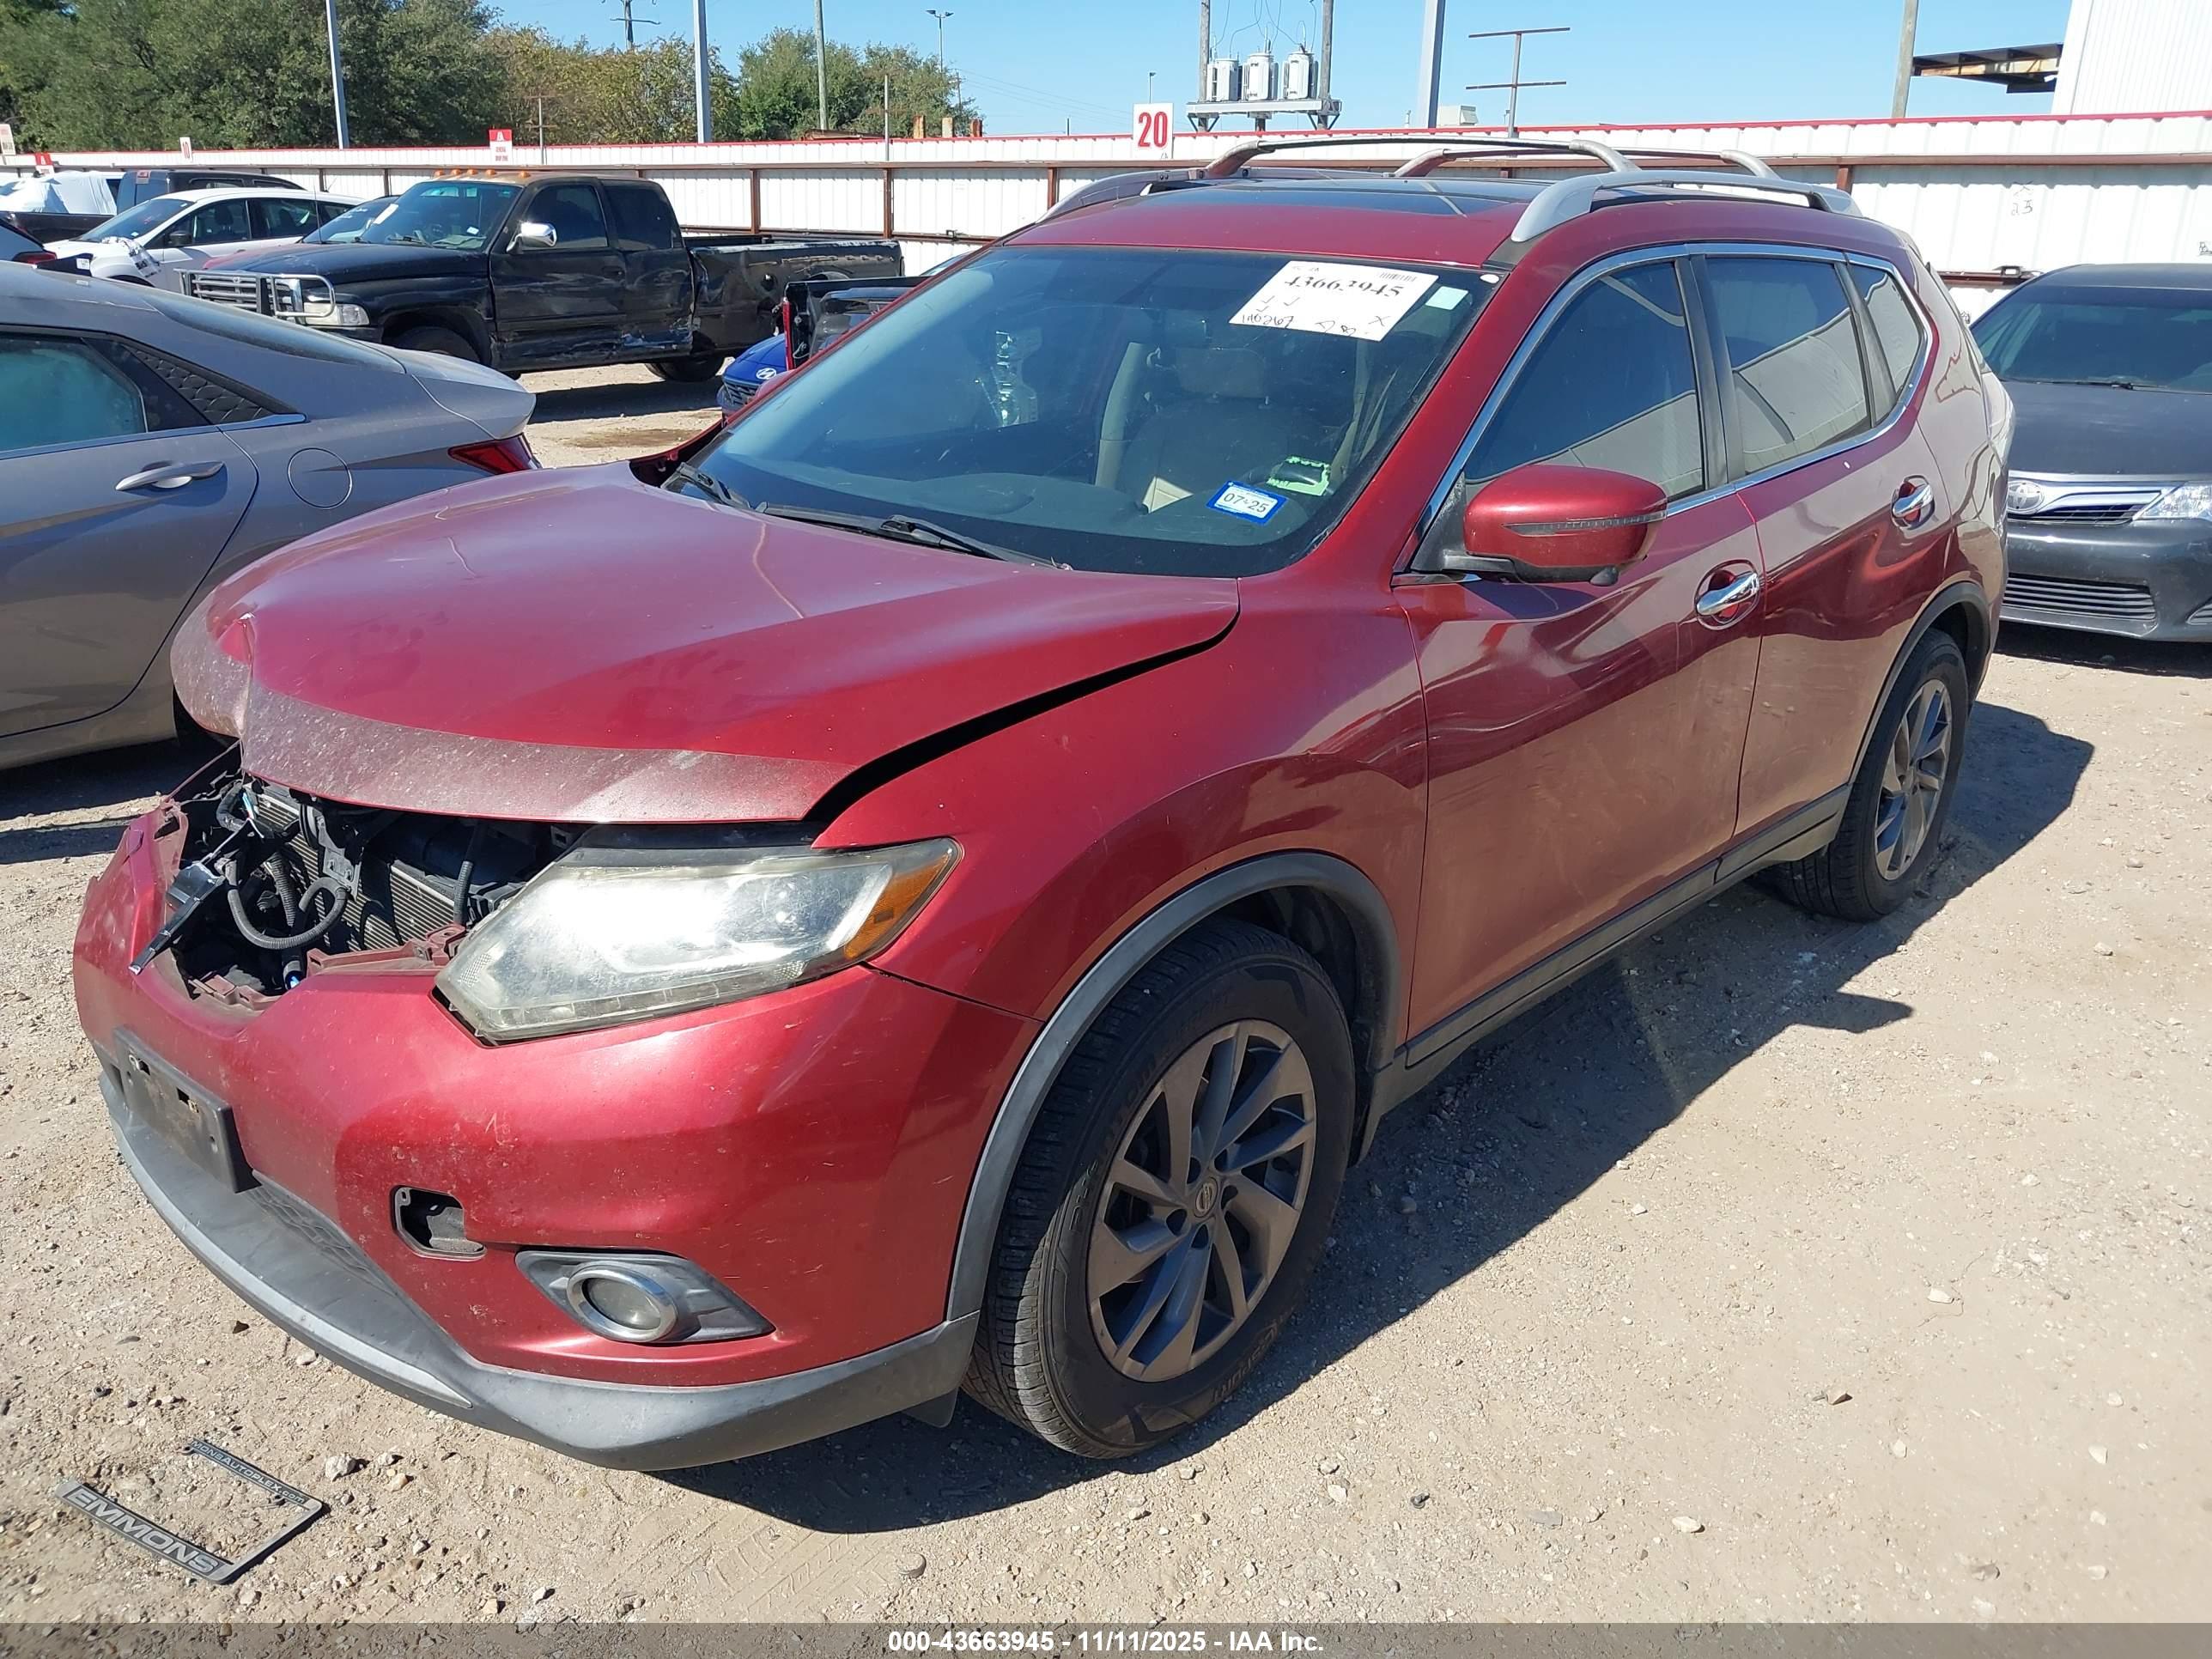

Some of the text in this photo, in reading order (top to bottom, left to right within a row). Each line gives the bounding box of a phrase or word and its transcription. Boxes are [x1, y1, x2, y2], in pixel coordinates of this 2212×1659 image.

[1138, 111, 1168, 148] 20
[1285, 275, 1404, 297] 43663945
[66, 1487, 220, 1574] EMMONS
